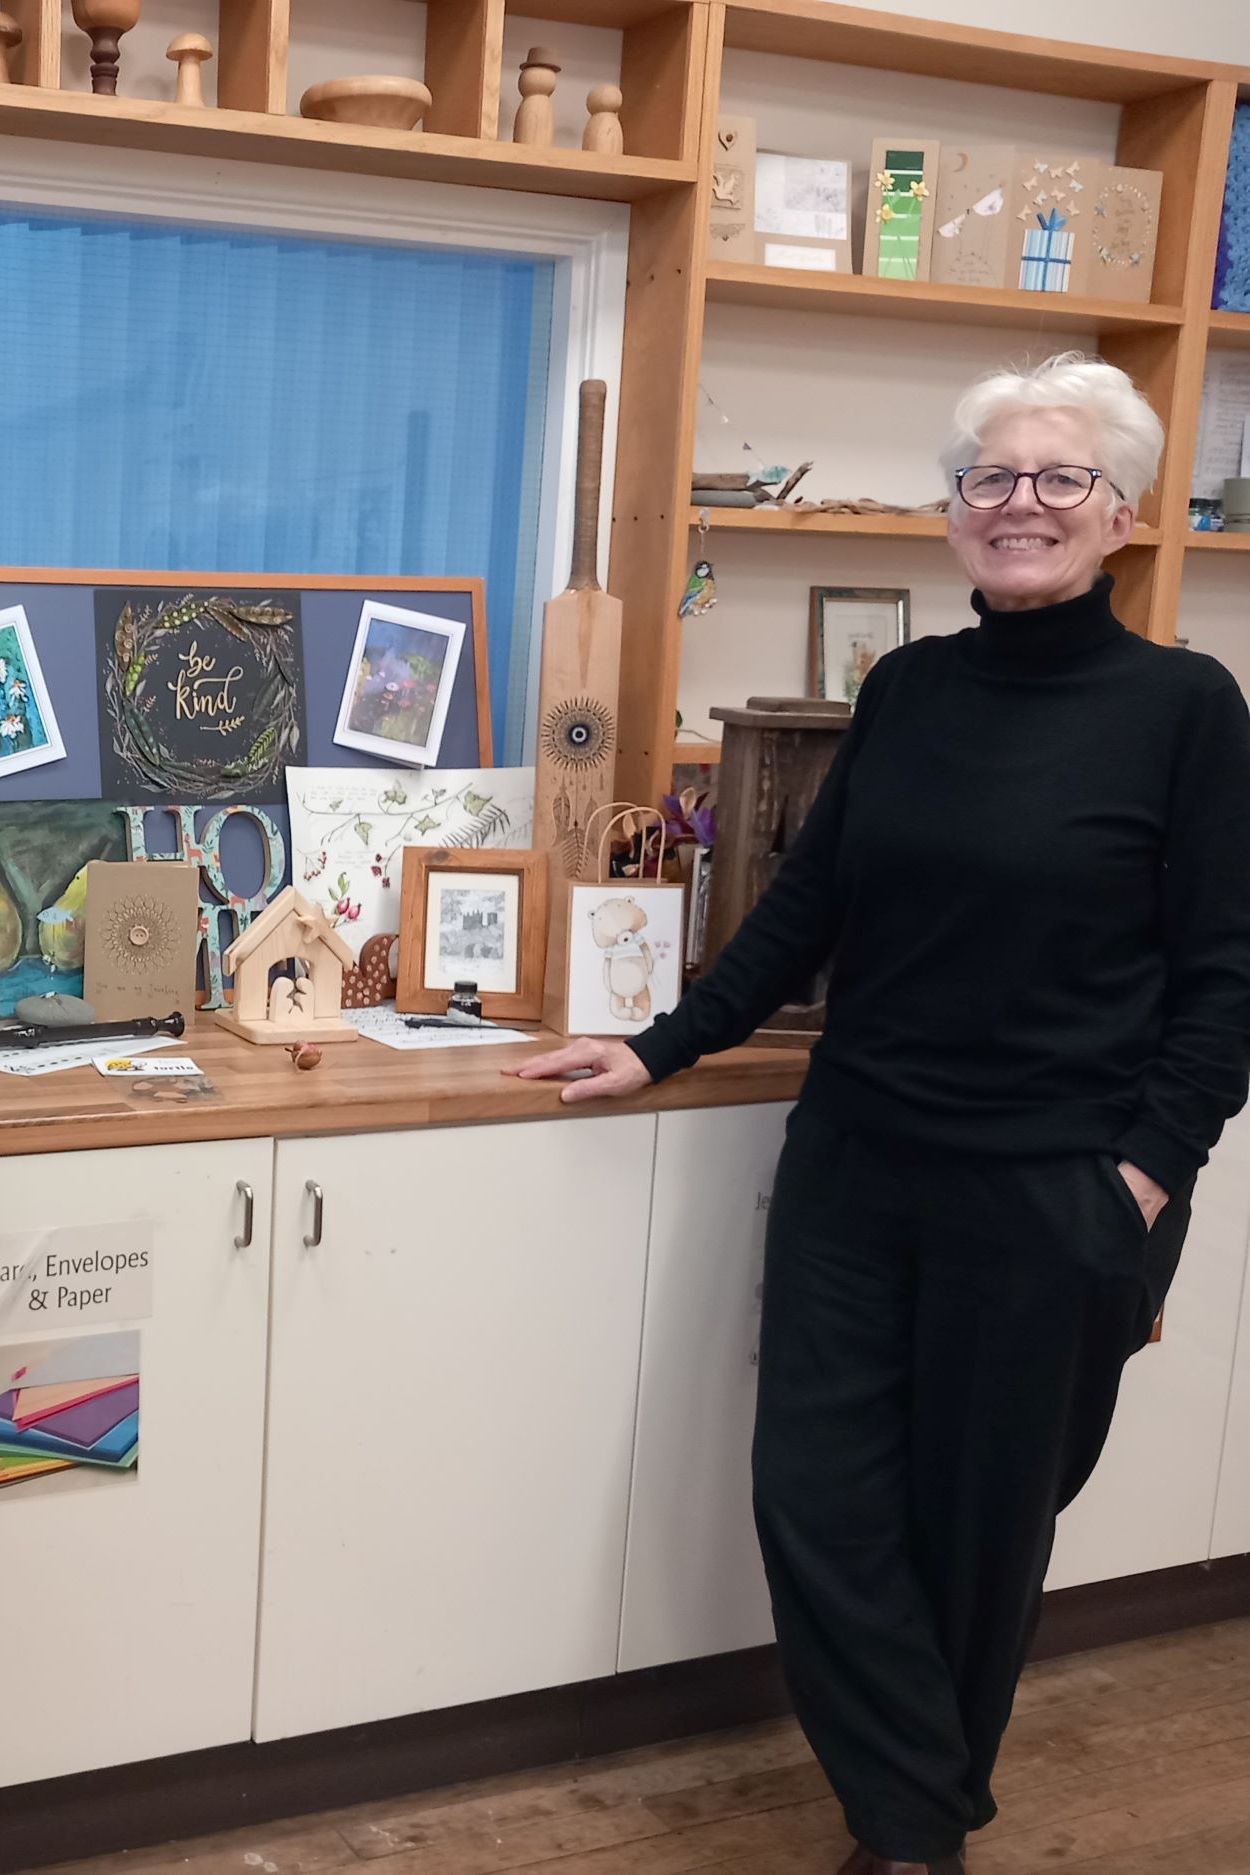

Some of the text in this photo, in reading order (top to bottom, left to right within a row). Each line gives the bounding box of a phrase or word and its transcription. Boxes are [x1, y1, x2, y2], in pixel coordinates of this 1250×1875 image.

[178, 640, 216, 677] be
[167, 666, 244, 720] kind
[46, 1250, 149, 1278] Envelopes
[28, 1286, 112, 1311] & Paper
